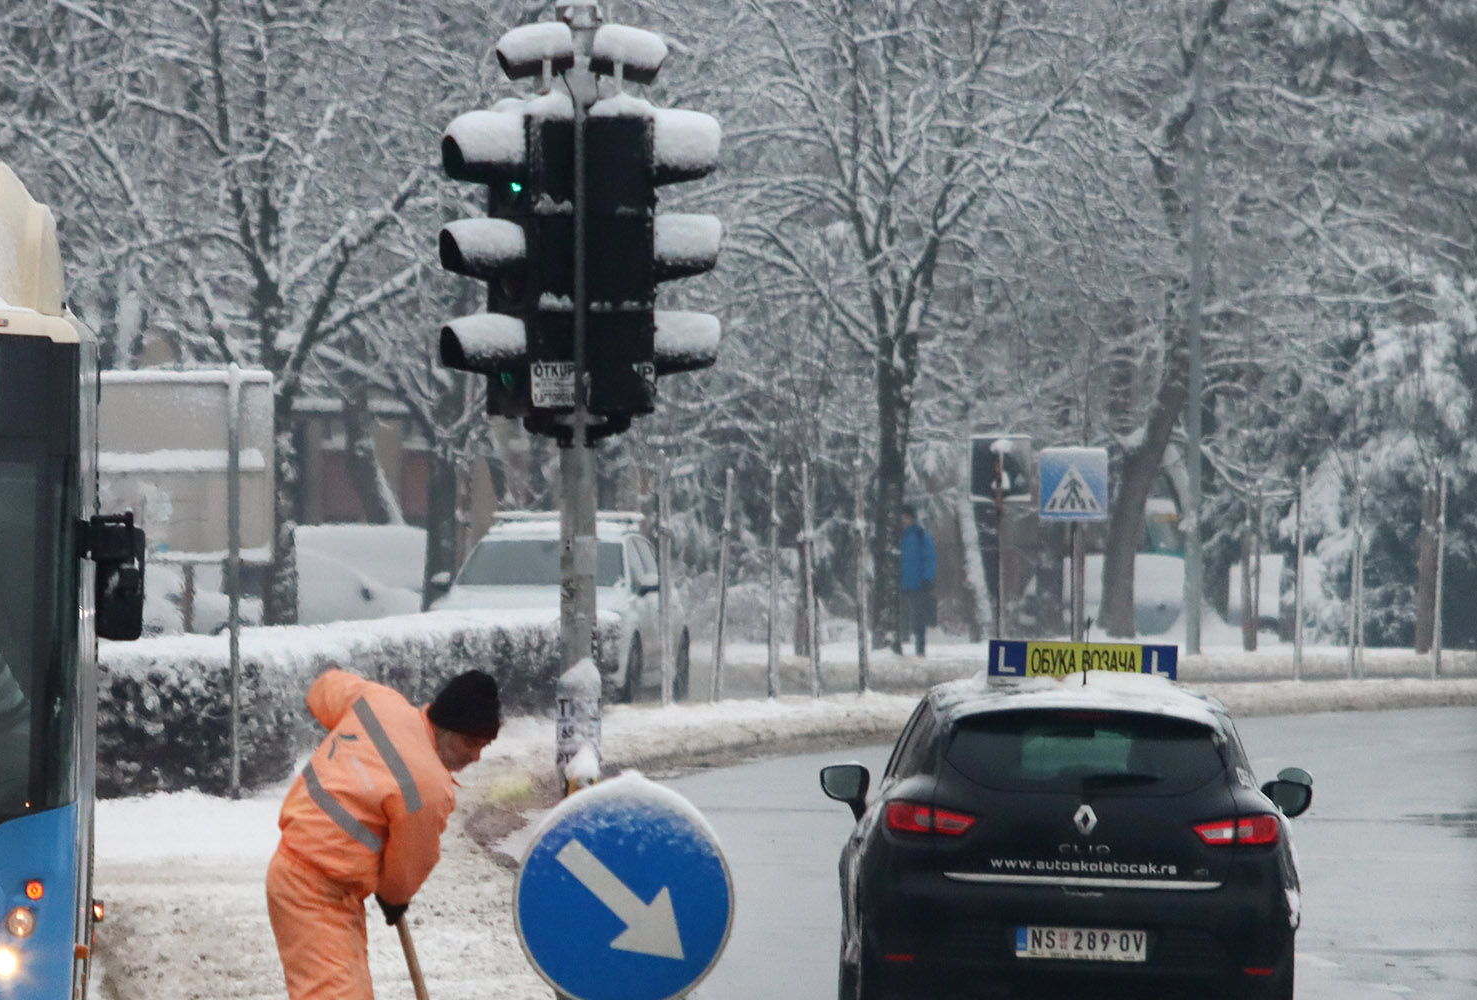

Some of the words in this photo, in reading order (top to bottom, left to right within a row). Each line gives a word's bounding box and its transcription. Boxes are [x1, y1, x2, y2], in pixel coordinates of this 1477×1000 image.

[998, 646, 1017, 673] L
[1031, 647, 1076, 674] ОБУКА
[1082, 649, 1136, 673] ВОЗАЧА
[1151, 650, 1169, 678] L
[1058, 843, 1111, 856] CLIO
[990, 858, 1178, 876] www.autoskolatocak.rs
[1031, 930, 1056, 950] NS
